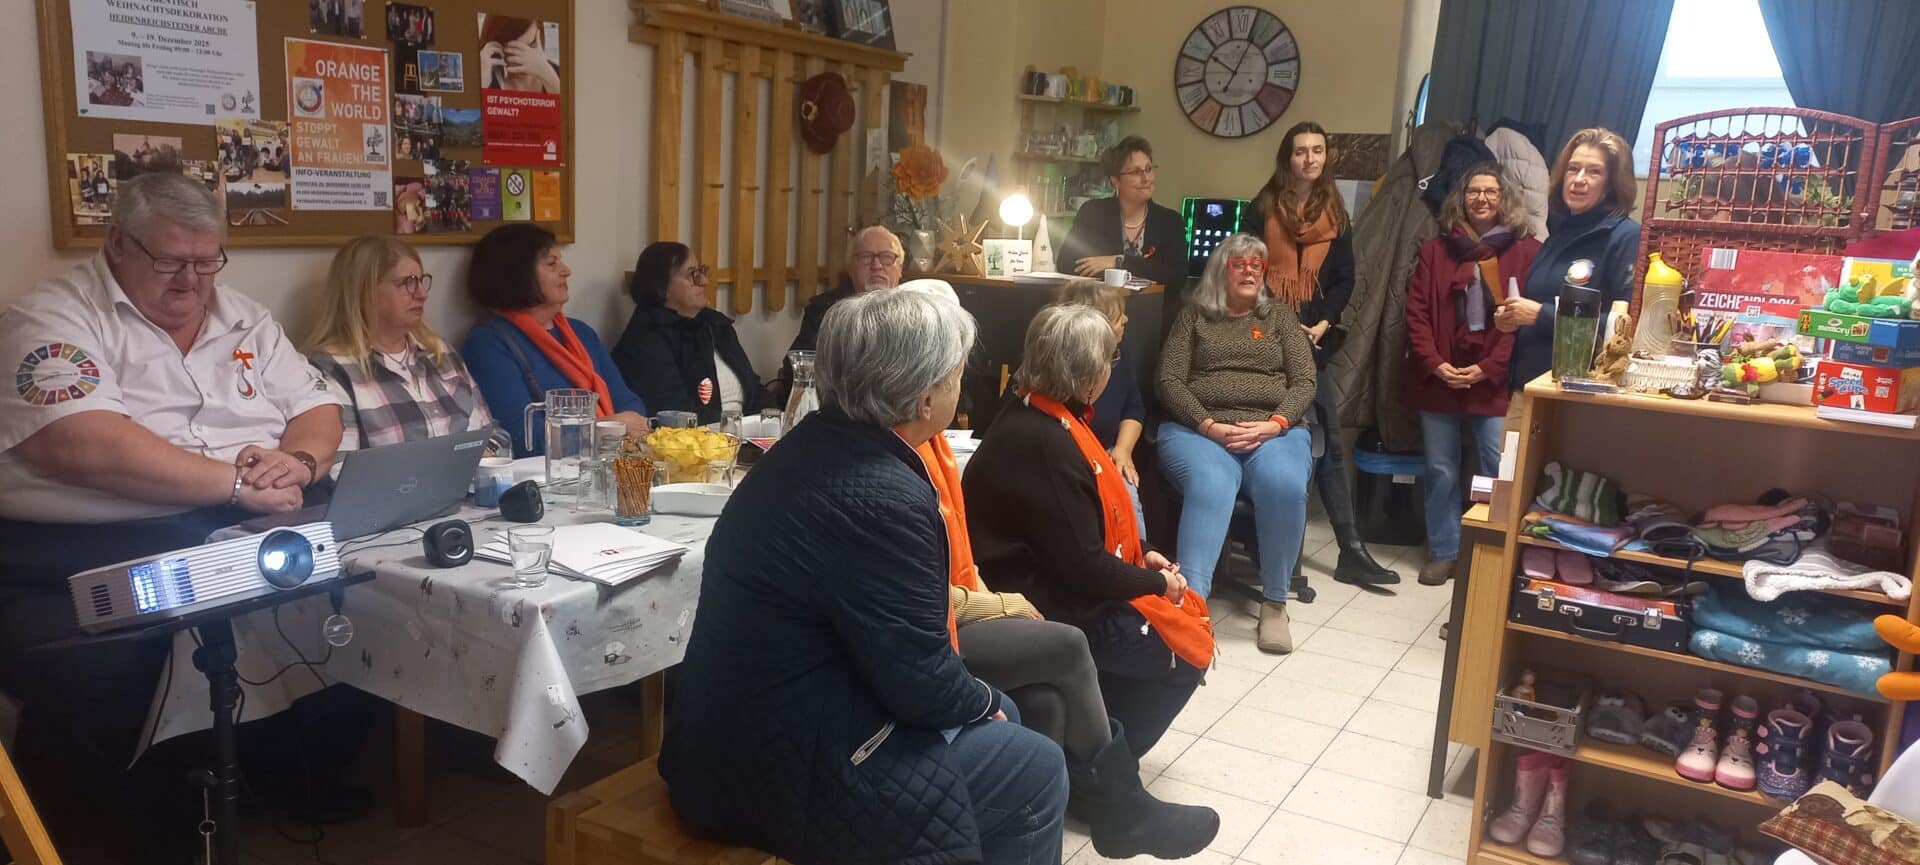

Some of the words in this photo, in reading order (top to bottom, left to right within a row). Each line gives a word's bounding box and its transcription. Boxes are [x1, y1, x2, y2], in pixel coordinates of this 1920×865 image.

[106, 0, 229, 22] WEIHNACHTSDEKORATION
[109, 13, 200, 32] HEIDENREICHSTEINER
[202, 25, 227, 35] ARCHE
[158, 34, 192, 46] Dezember
[315, 59, 381, 82] ORANGE
[351, 84, 381, 102] THE
[487, 95, 498, 104] IST
[499, 96, 556, 108] PSYCHOTERROR
[331, 103, 381, 121] WORLD
[487, 106, 520, 117] GEWALT?
[296, 122, 338, 135] STOPPT
[296, 136, 340, 150] GEWALT
[297, 152, 313, 163] AN
[295, 168, 372, 179] INFO-VERANSTALTUNG
[1817, 324, 1851, 337] memory
[1828, 376, 1863, 391] Speed
